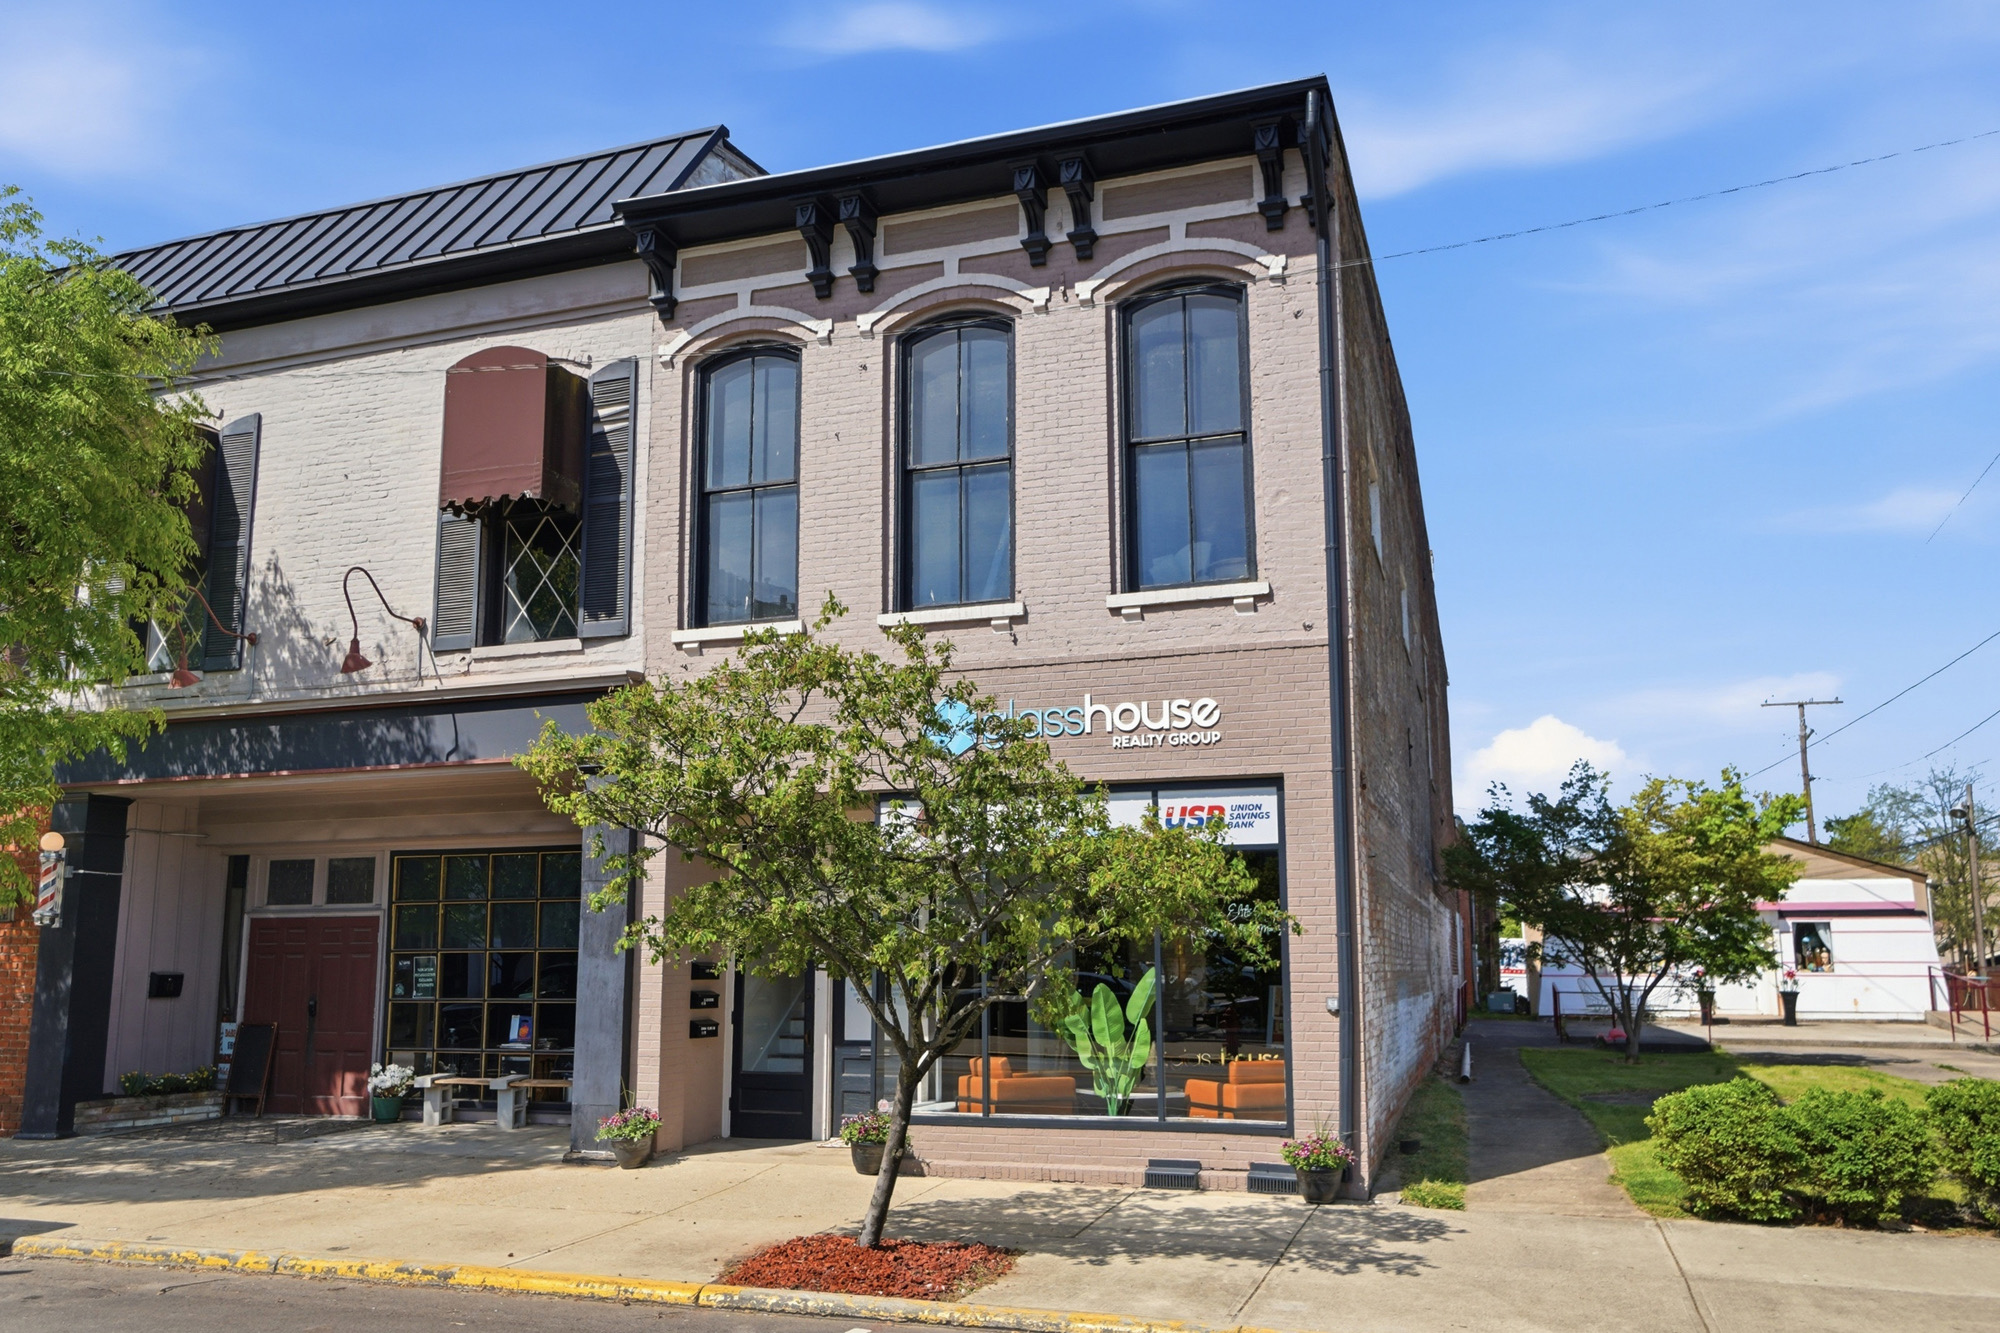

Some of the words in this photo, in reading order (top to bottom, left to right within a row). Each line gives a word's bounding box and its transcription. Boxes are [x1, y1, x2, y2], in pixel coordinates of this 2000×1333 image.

[1112, 733, 1165, 748] REALTY
[1168, 731, 1221, 746] GROUP
[1230, 803, 1262, 812] UNION
[1229, 811, 1270, 820] SAVINGS
[1227, 820, 1255, 829] BANK
